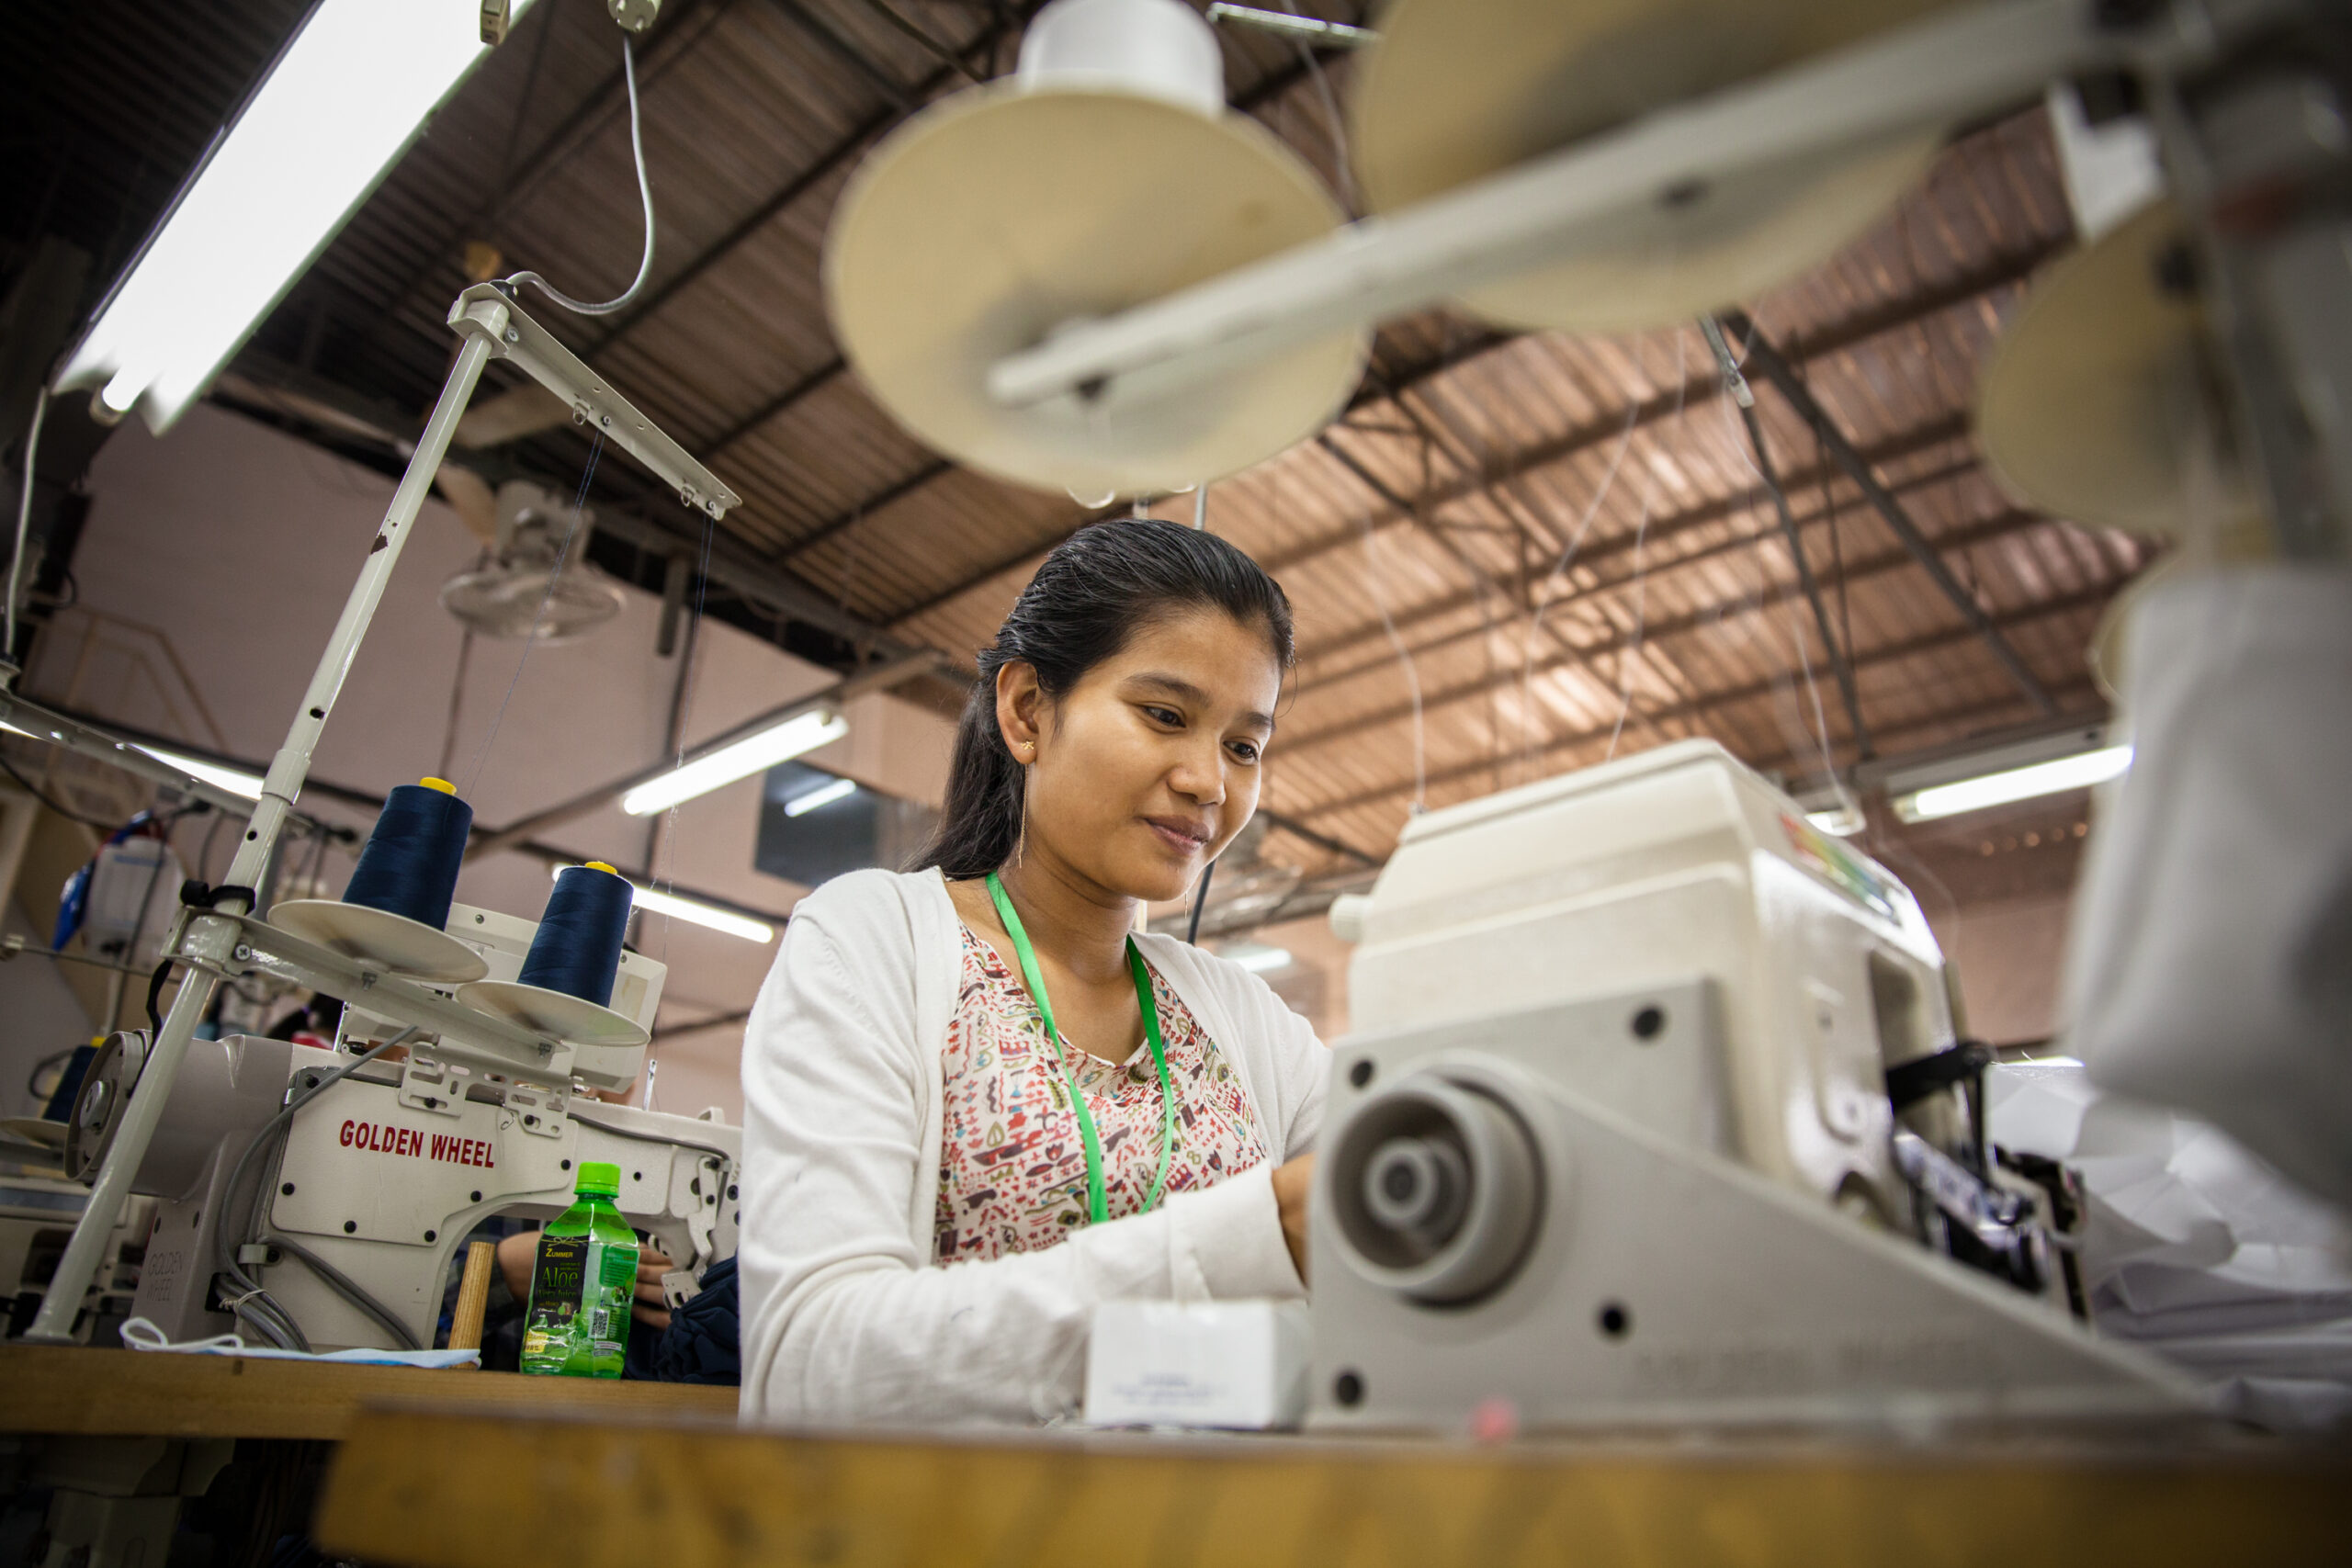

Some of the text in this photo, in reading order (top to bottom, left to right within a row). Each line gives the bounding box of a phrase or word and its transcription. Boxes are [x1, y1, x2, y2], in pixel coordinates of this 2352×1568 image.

[339, 1119, 494, 1168] GOLDEN WHEEL
[545, 1247, 573, 1258] ZUMMER
[538, 1266, 579, 1288] Aloe
